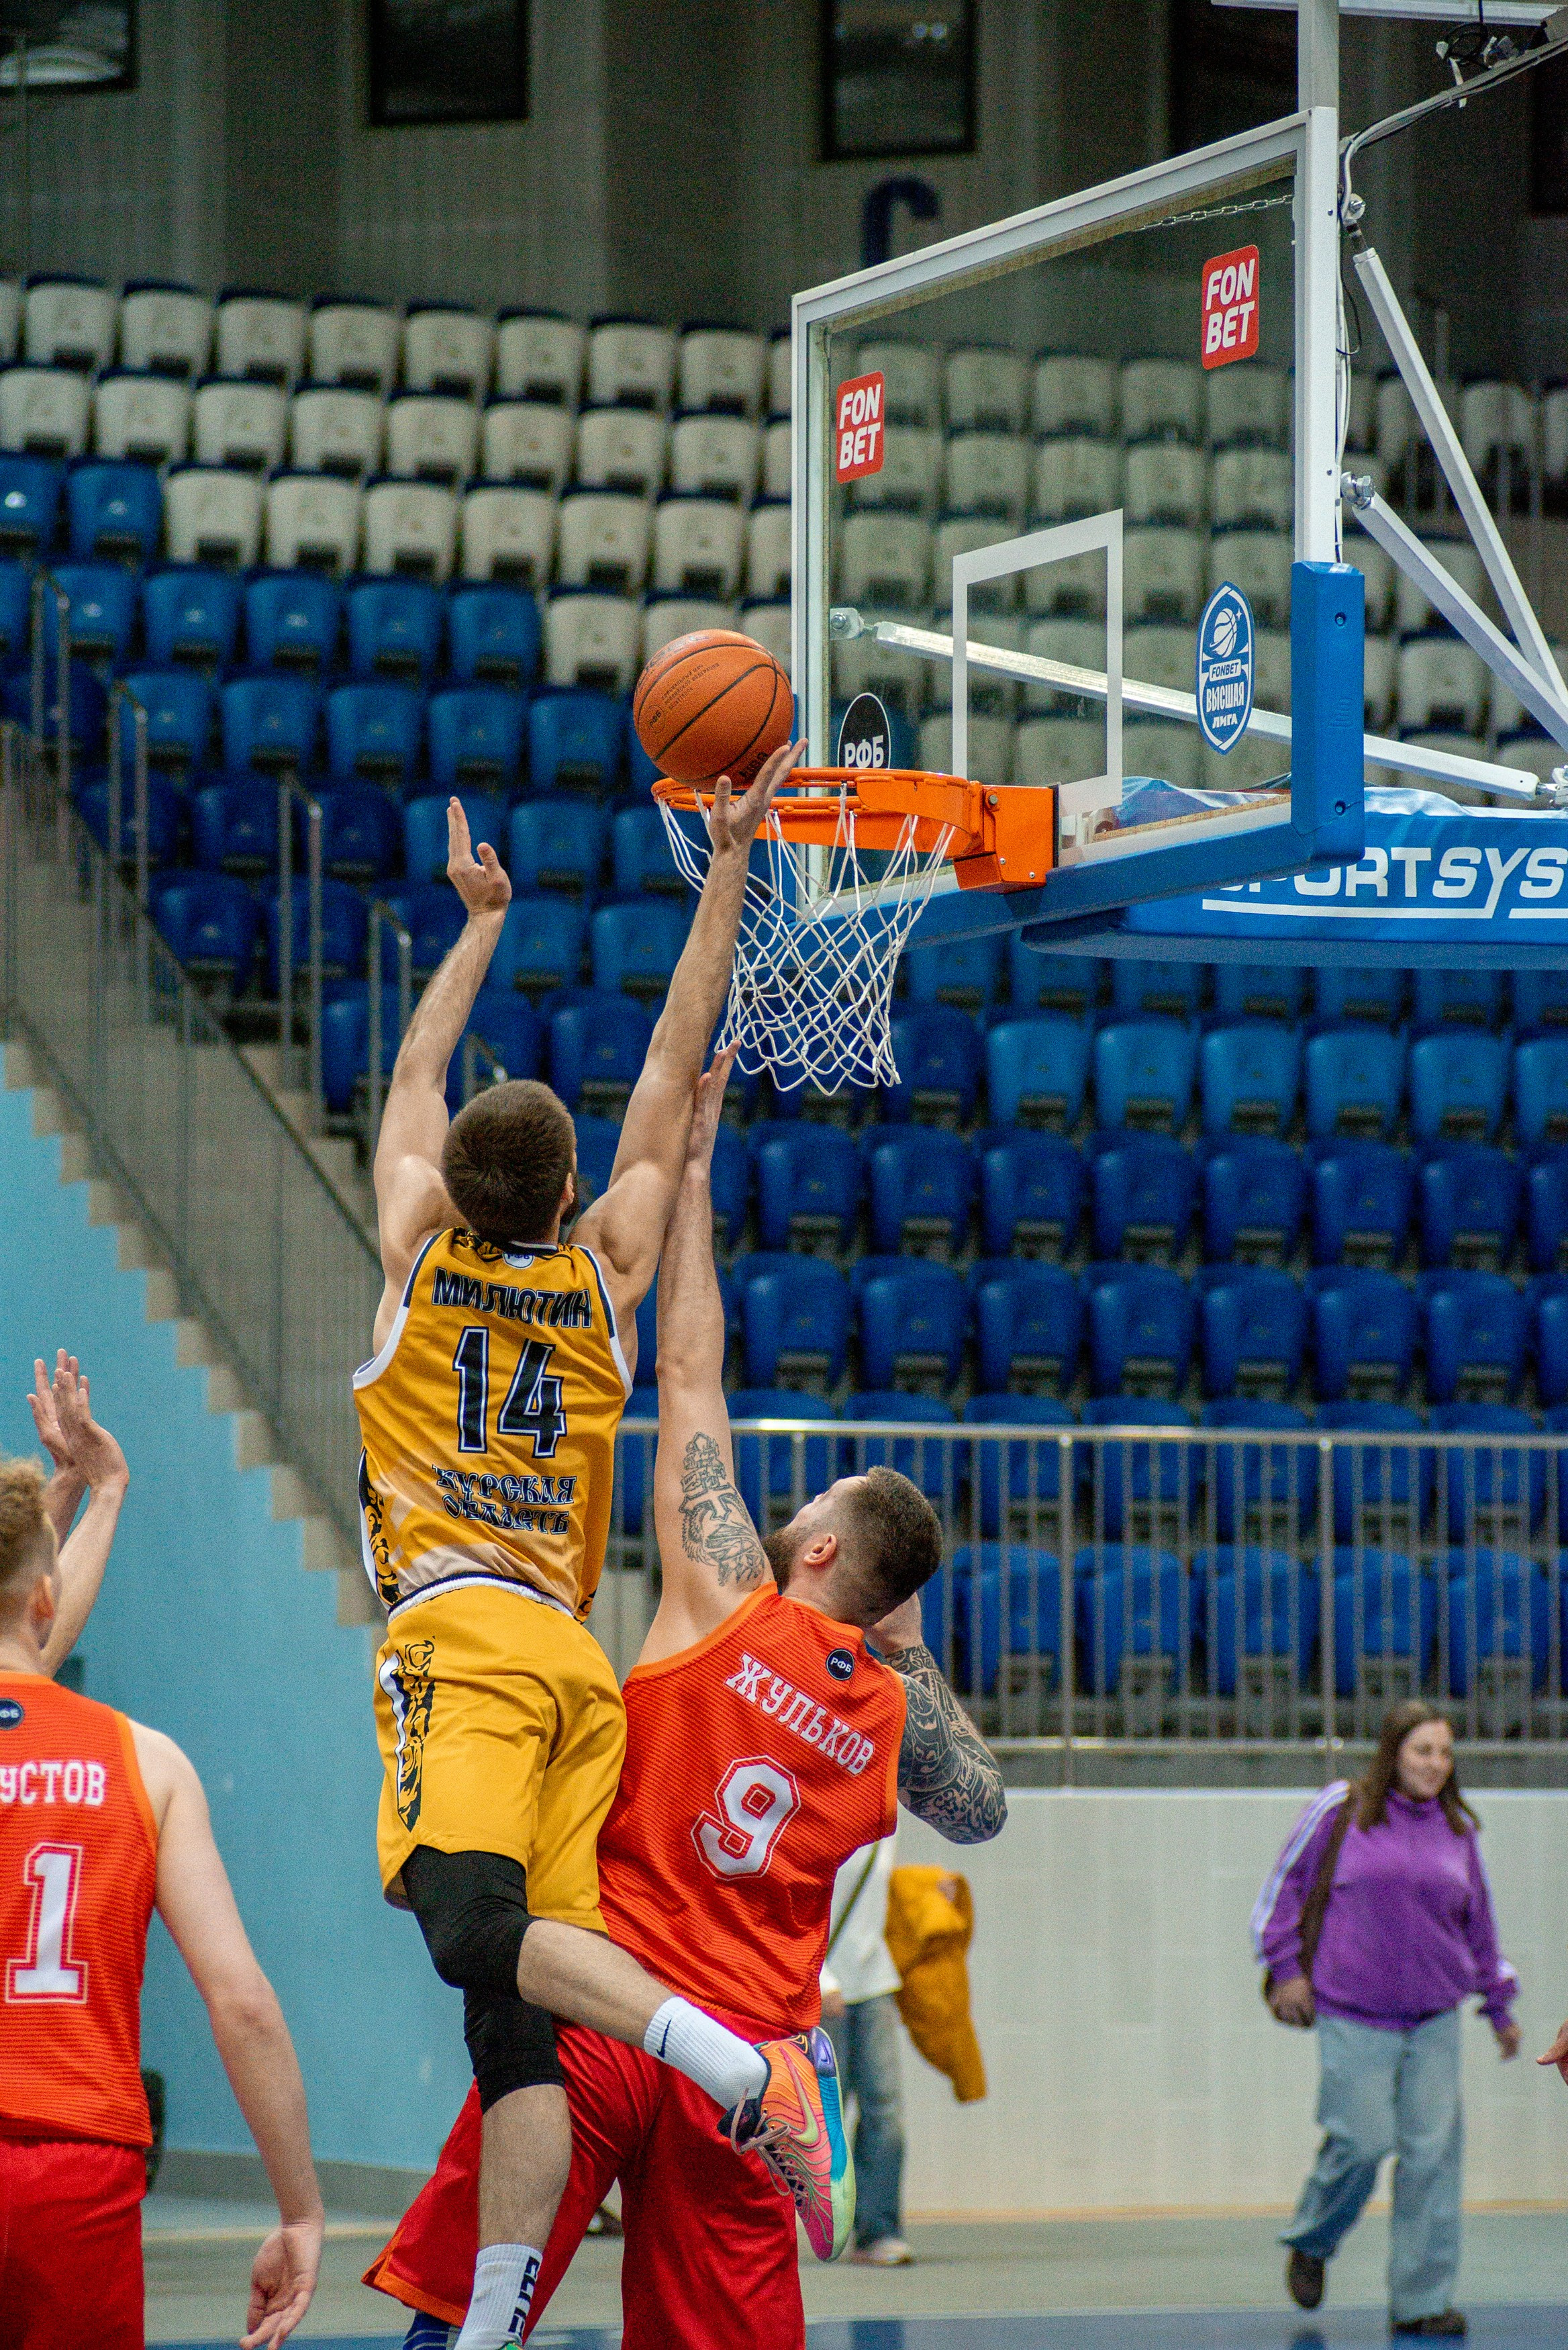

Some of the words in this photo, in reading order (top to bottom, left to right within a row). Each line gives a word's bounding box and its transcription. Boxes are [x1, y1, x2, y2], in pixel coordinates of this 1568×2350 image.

[1206, 258, 1255, 311] FON
[1206, 301, 1255, 354] BET
[839, 383, 881, 430] FON
[839, 422, 881, 469] BET
[1211, 662, 1239, 678] FONBET
[1206, 682, 1244, 712] ВЫСШАЯ
[1212, 713, 1238, 728] ЛИГА
[844, 735, 884, 768] РФБ
[1220, 847, 1568, 919] ORTSYS
[432, 1267, 592, 1328] МИЛЮТИН
[452, 1325, 569, 1458] 14
[432, 1464, 577, 1505] КУРСКАЯ
[442, 1494, 570, 1534] ОБЛАСТЬ
[830, 1656, 852, 1673] РФБ
[724, 1651, 875, 1776] ЖУЛЬКОВ
[691, 1754, 801, 1881] 9
[5, 1842, 88, 2004] 1
